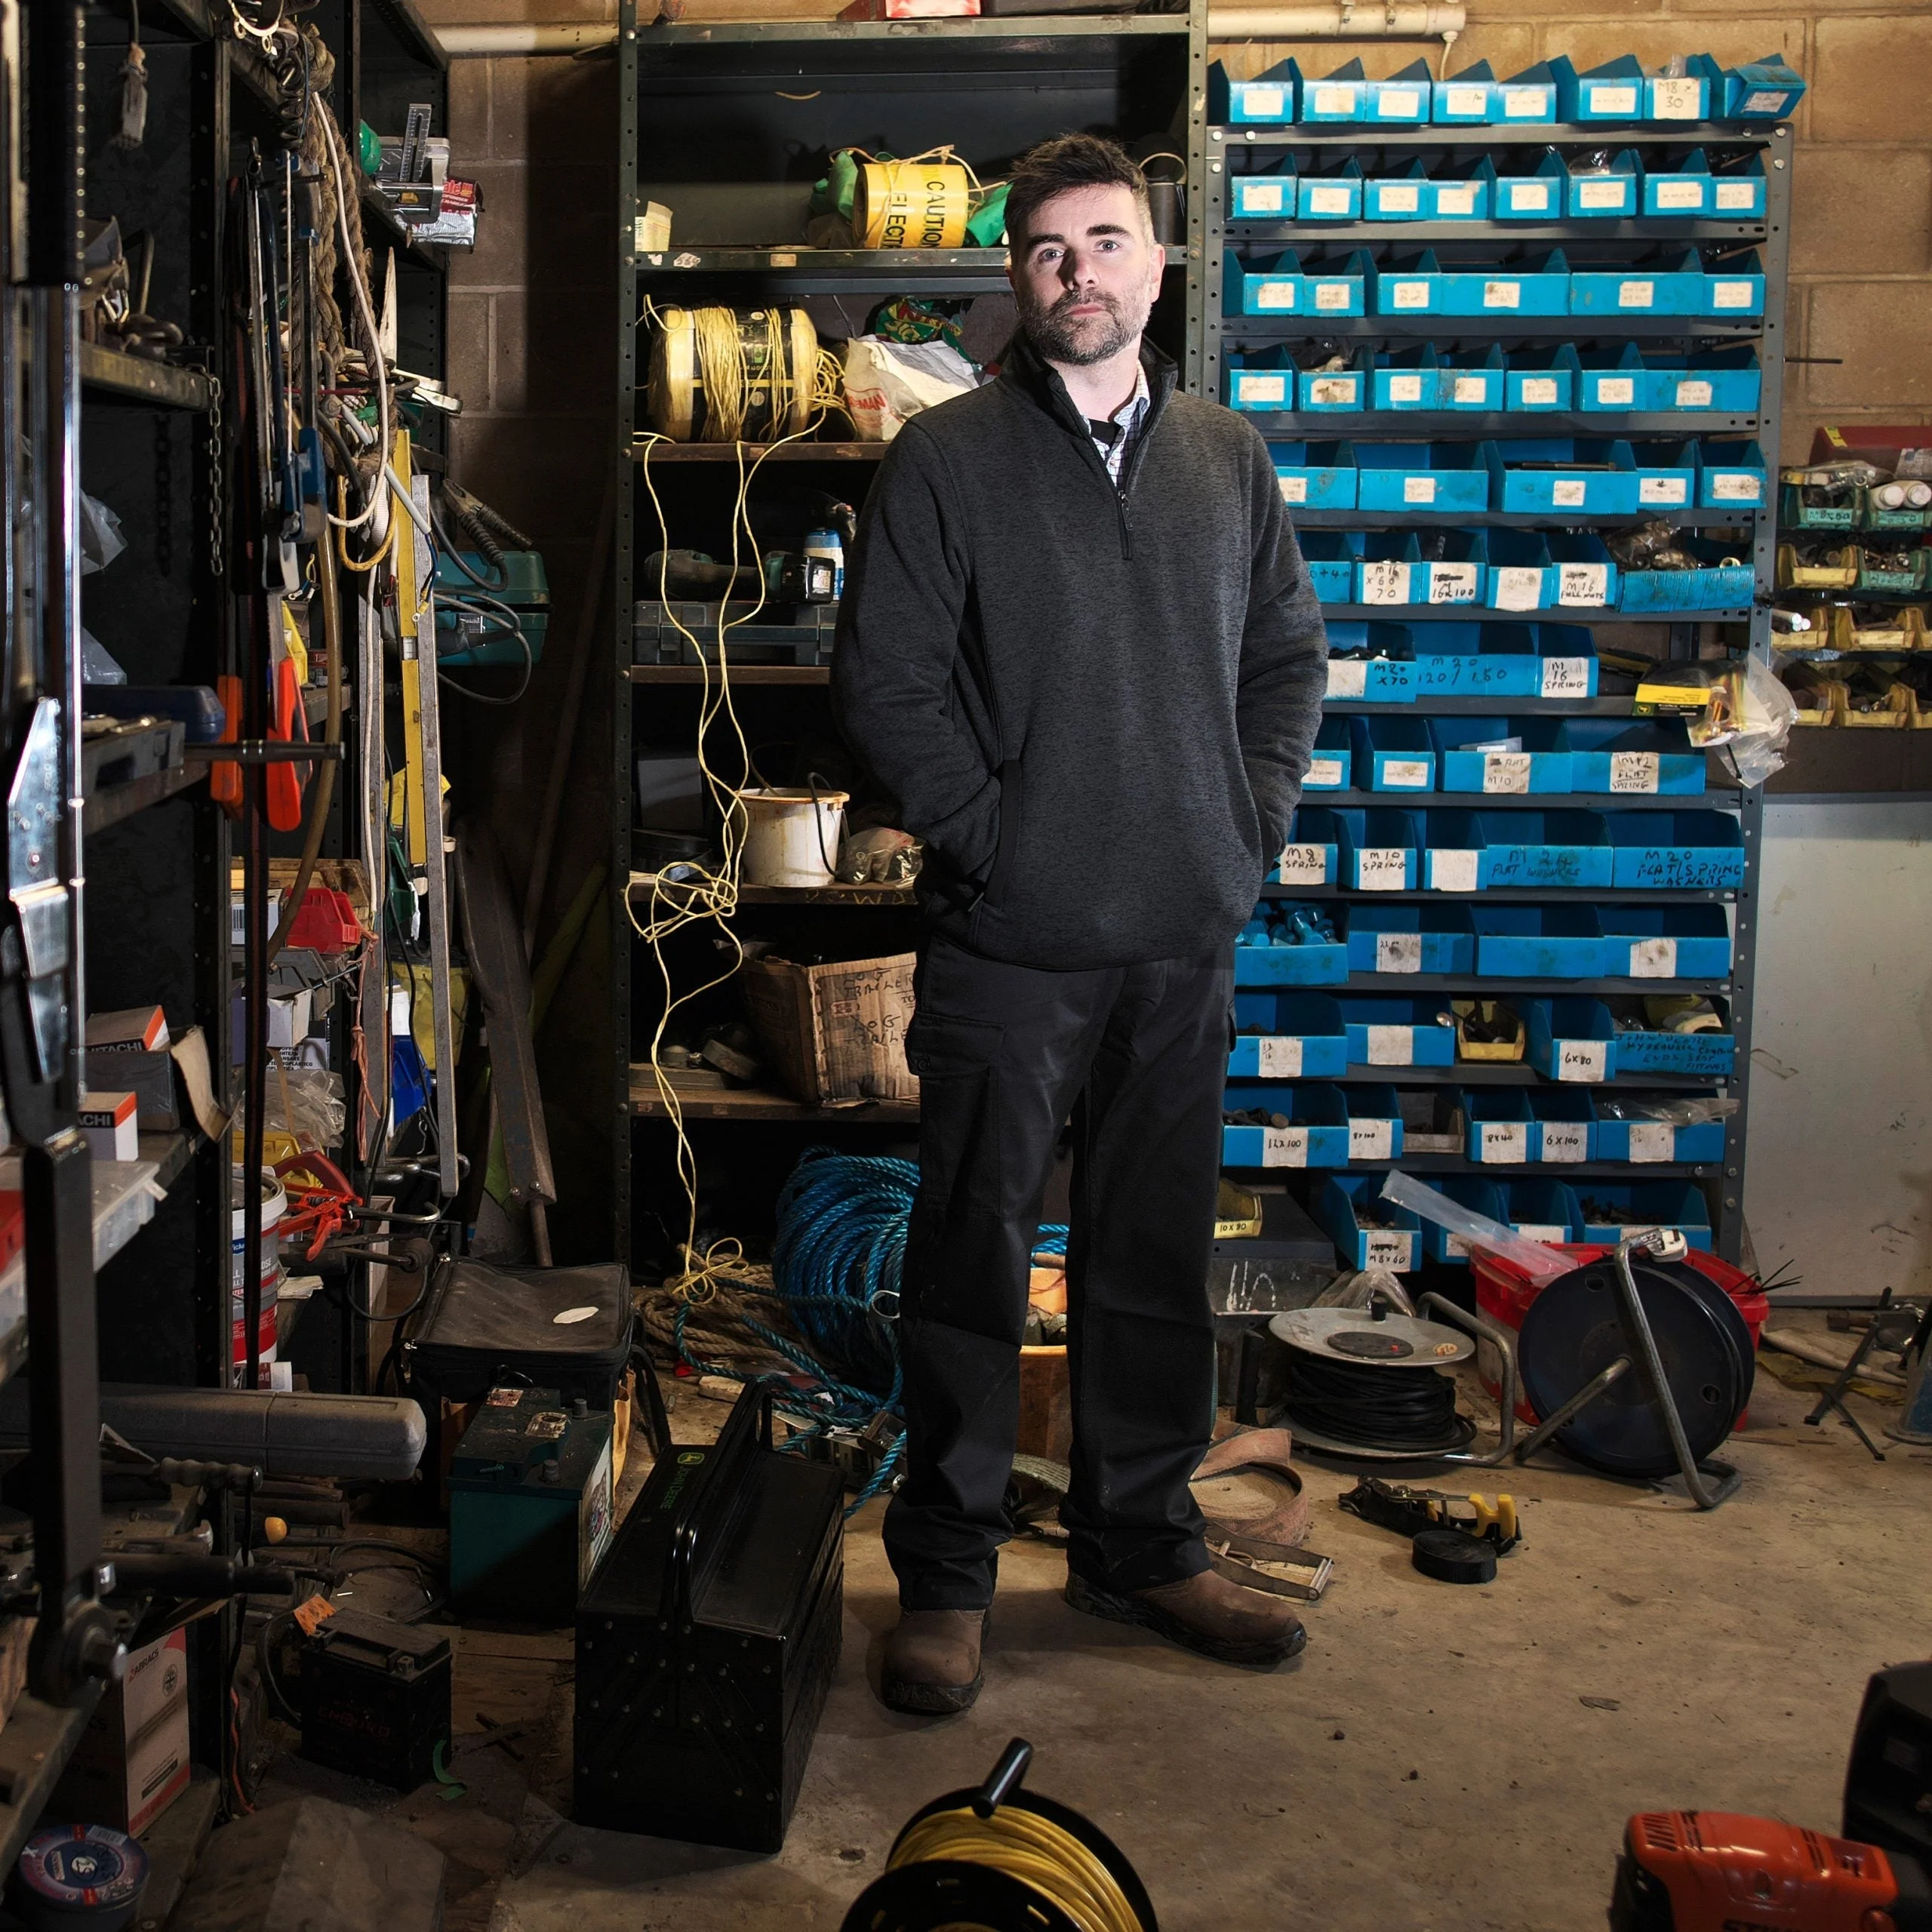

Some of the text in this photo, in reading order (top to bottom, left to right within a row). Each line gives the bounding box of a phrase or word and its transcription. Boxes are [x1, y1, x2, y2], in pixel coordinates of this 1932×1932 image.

[1666, 96, 1684, 108] 30
[1545, 681, 1587, 690] SPRING
[1285, 861, 1327, 869] SPRING
[1362, 861, 1406, 871] SPRING
